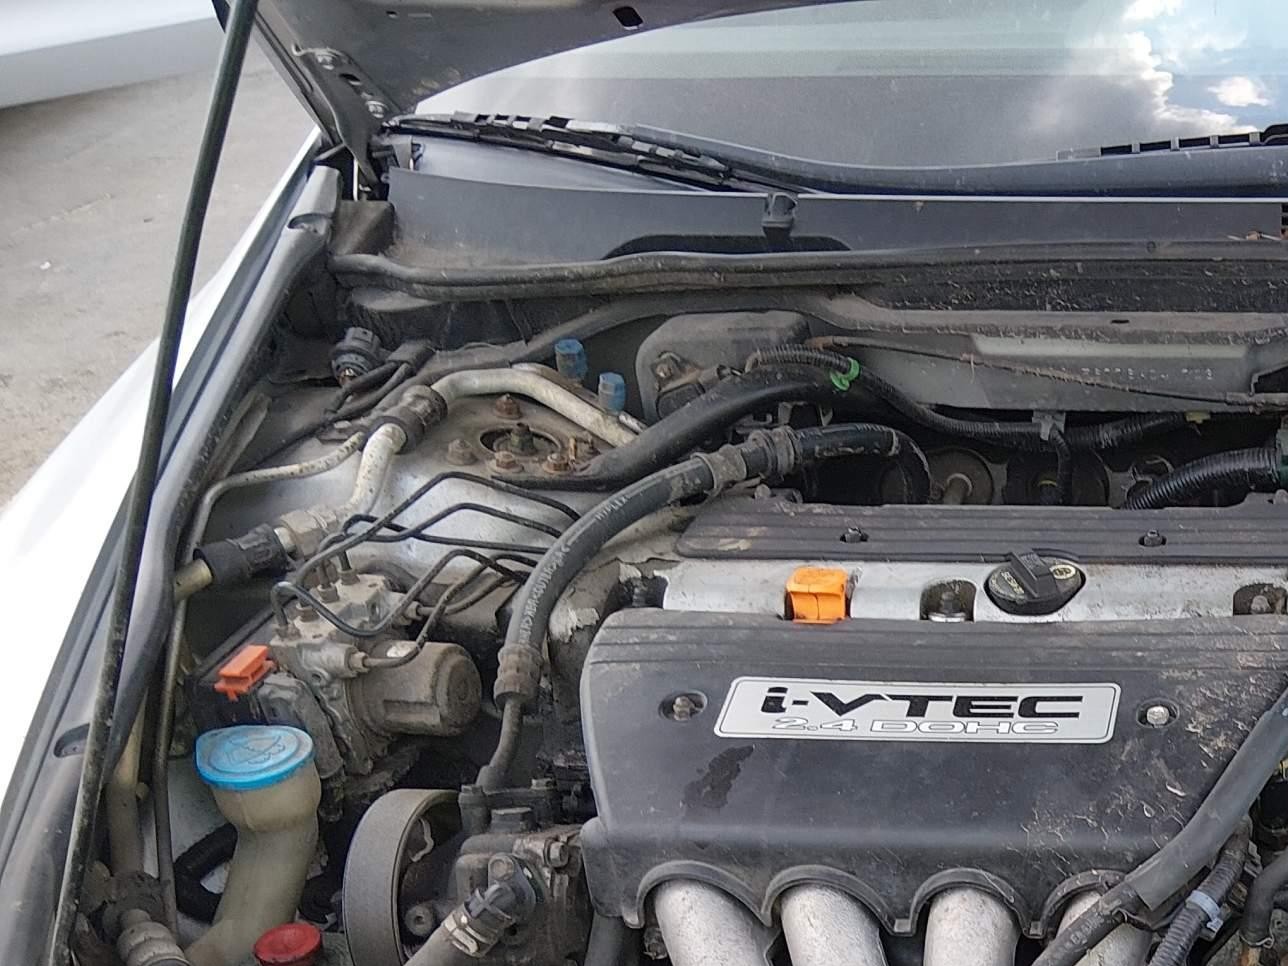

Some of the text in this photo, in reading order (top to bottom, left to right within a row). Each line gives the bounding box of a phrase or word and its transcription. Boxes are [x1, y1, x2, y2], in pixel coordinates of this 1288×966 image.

[760, 686, 1084, 719] i-VTEC
[772, 717, 1060, 735] 2.4 DOHC
